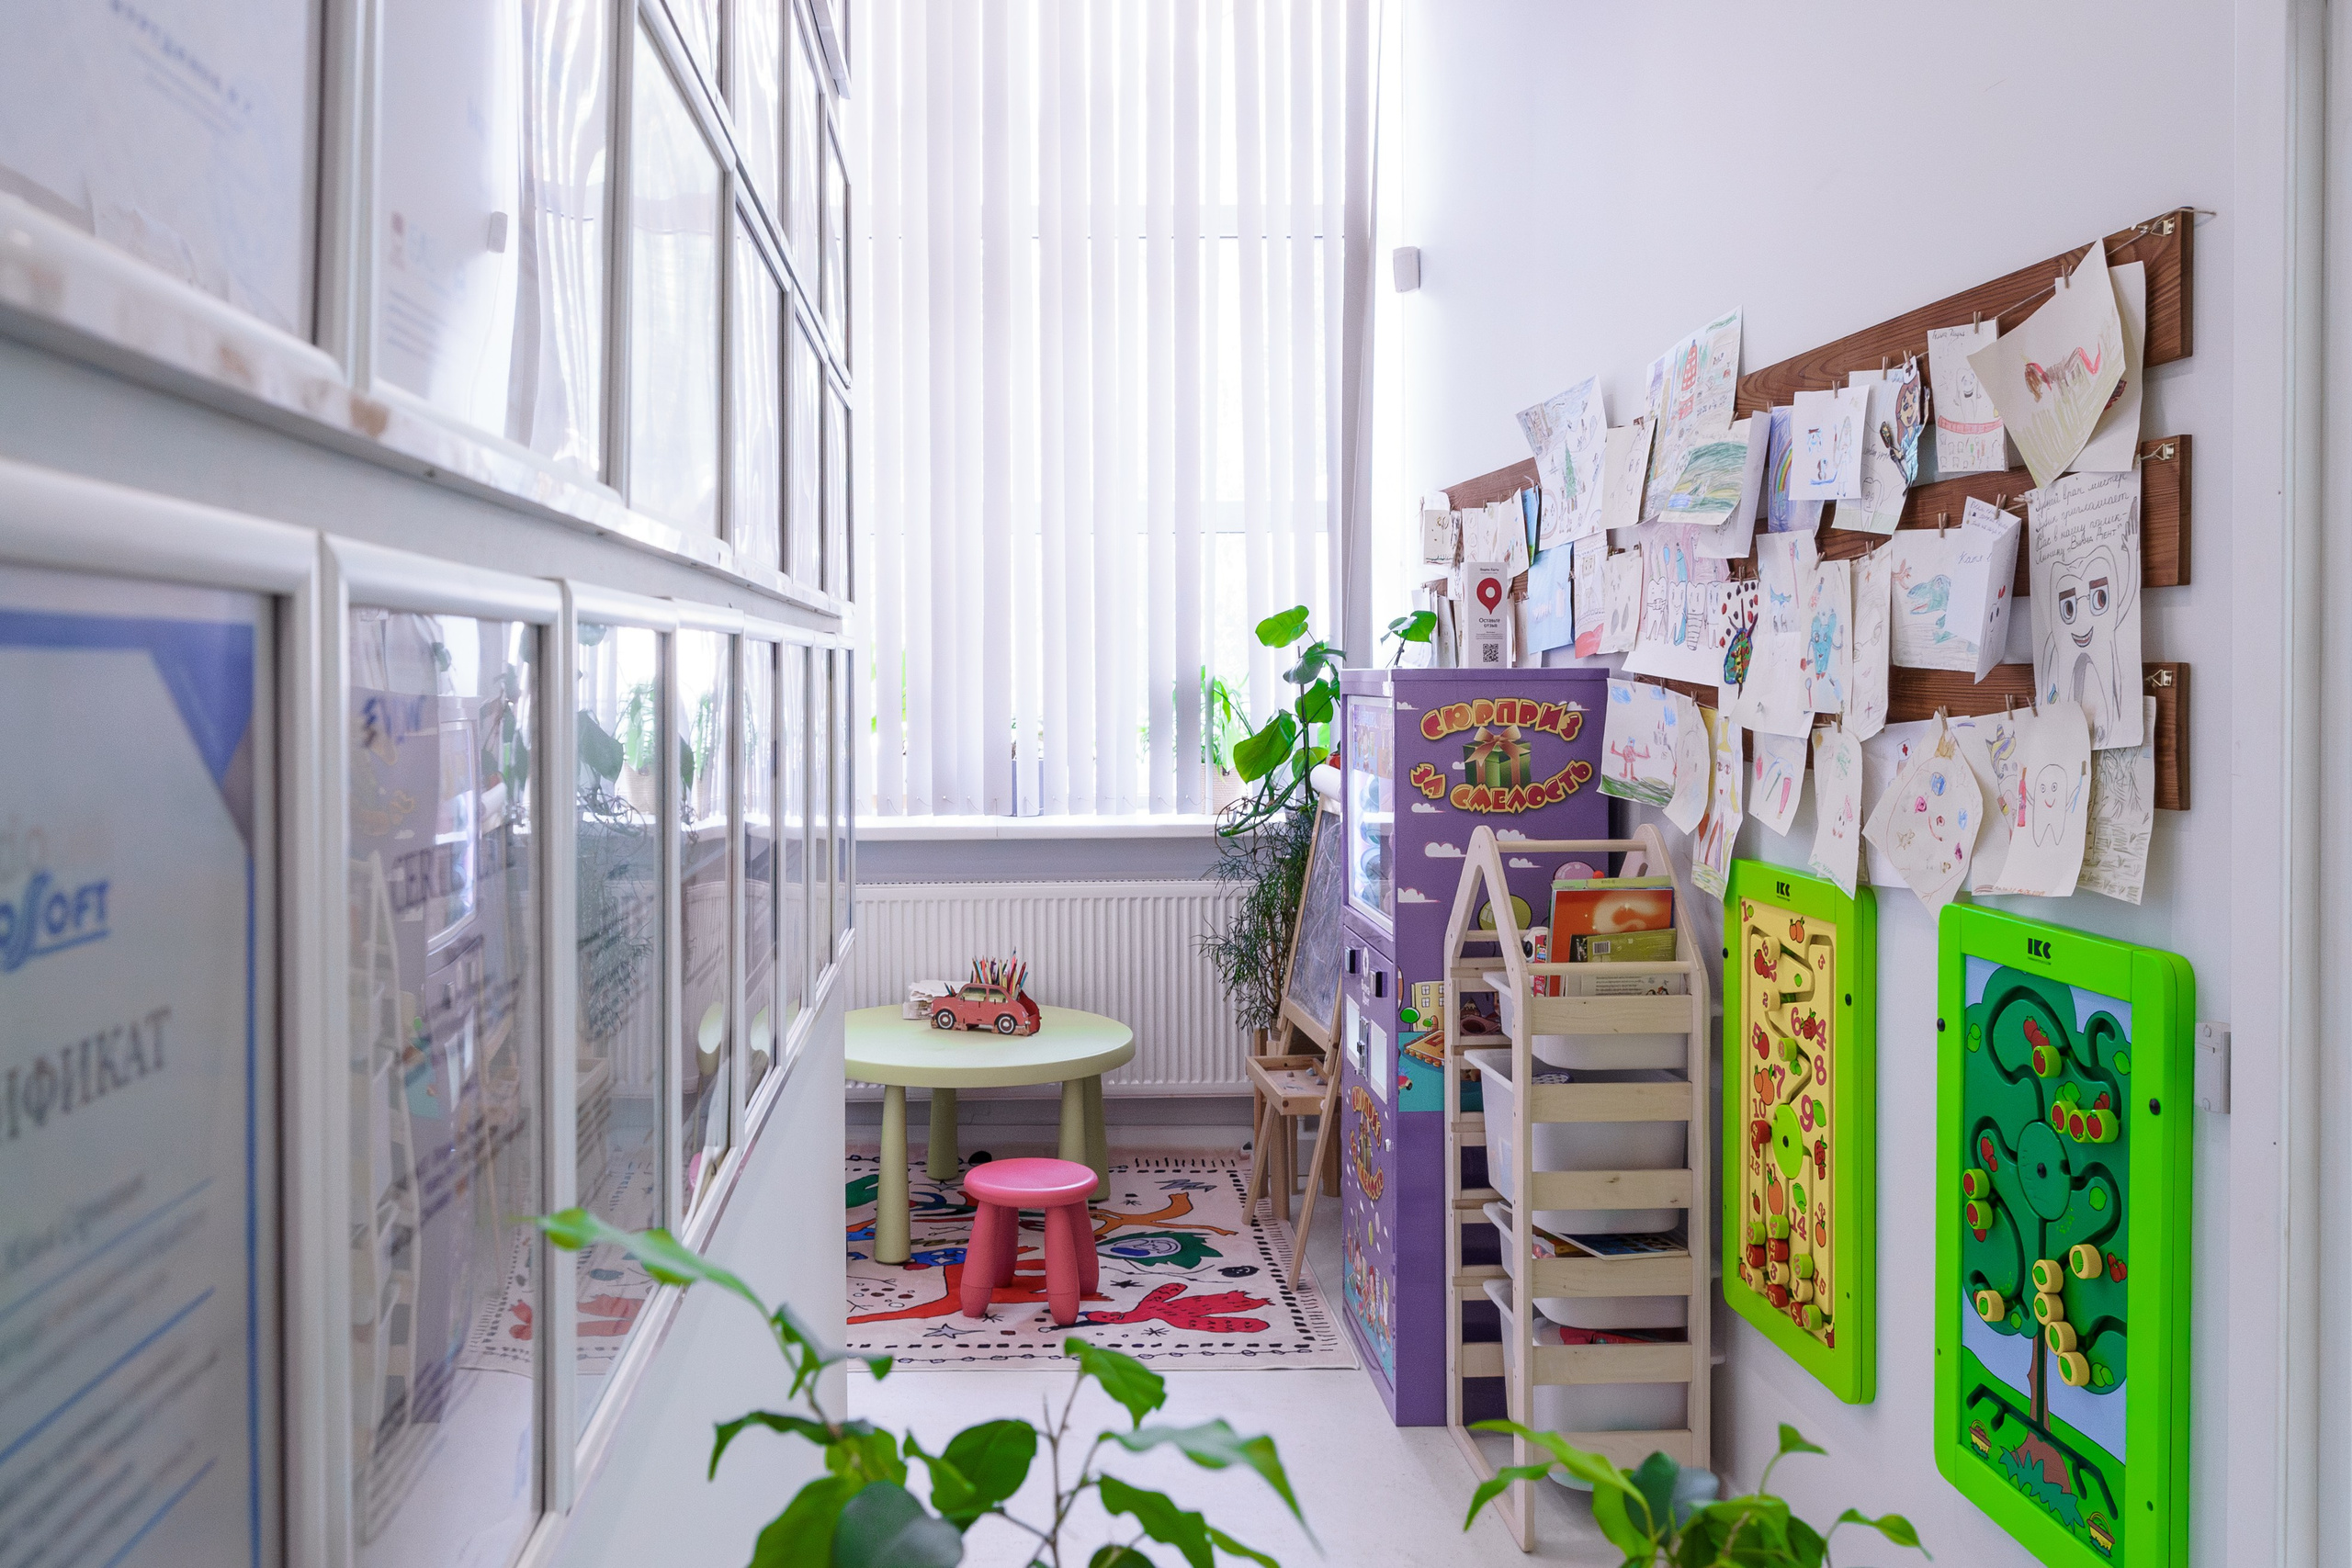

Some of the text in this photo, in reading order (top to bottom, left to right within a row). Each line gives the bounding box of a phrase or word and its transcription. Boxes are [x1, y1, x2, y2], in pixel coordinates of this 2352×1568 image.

[1420, 698, 1583, 741] СЮРПРИЗ
[1409, 760, 1593, 814] ЗА СМЕЛОСТЬ
[1741, 901, 1749, 922] 1
[2028, 938, 2052, 960] IKC
[1791, 1007, 1802, 1036] 6
[1816, 1019, 1826, 1051] 4
[1773, 1064, 1785, 1100] 7
[1815, 1055, 1826, 1086] 8
[1752, 1098, 1766, 1119] 10
[1800, 1094, 1814, 1133] 9
[1791, 1206, 1807, 1241] 14
